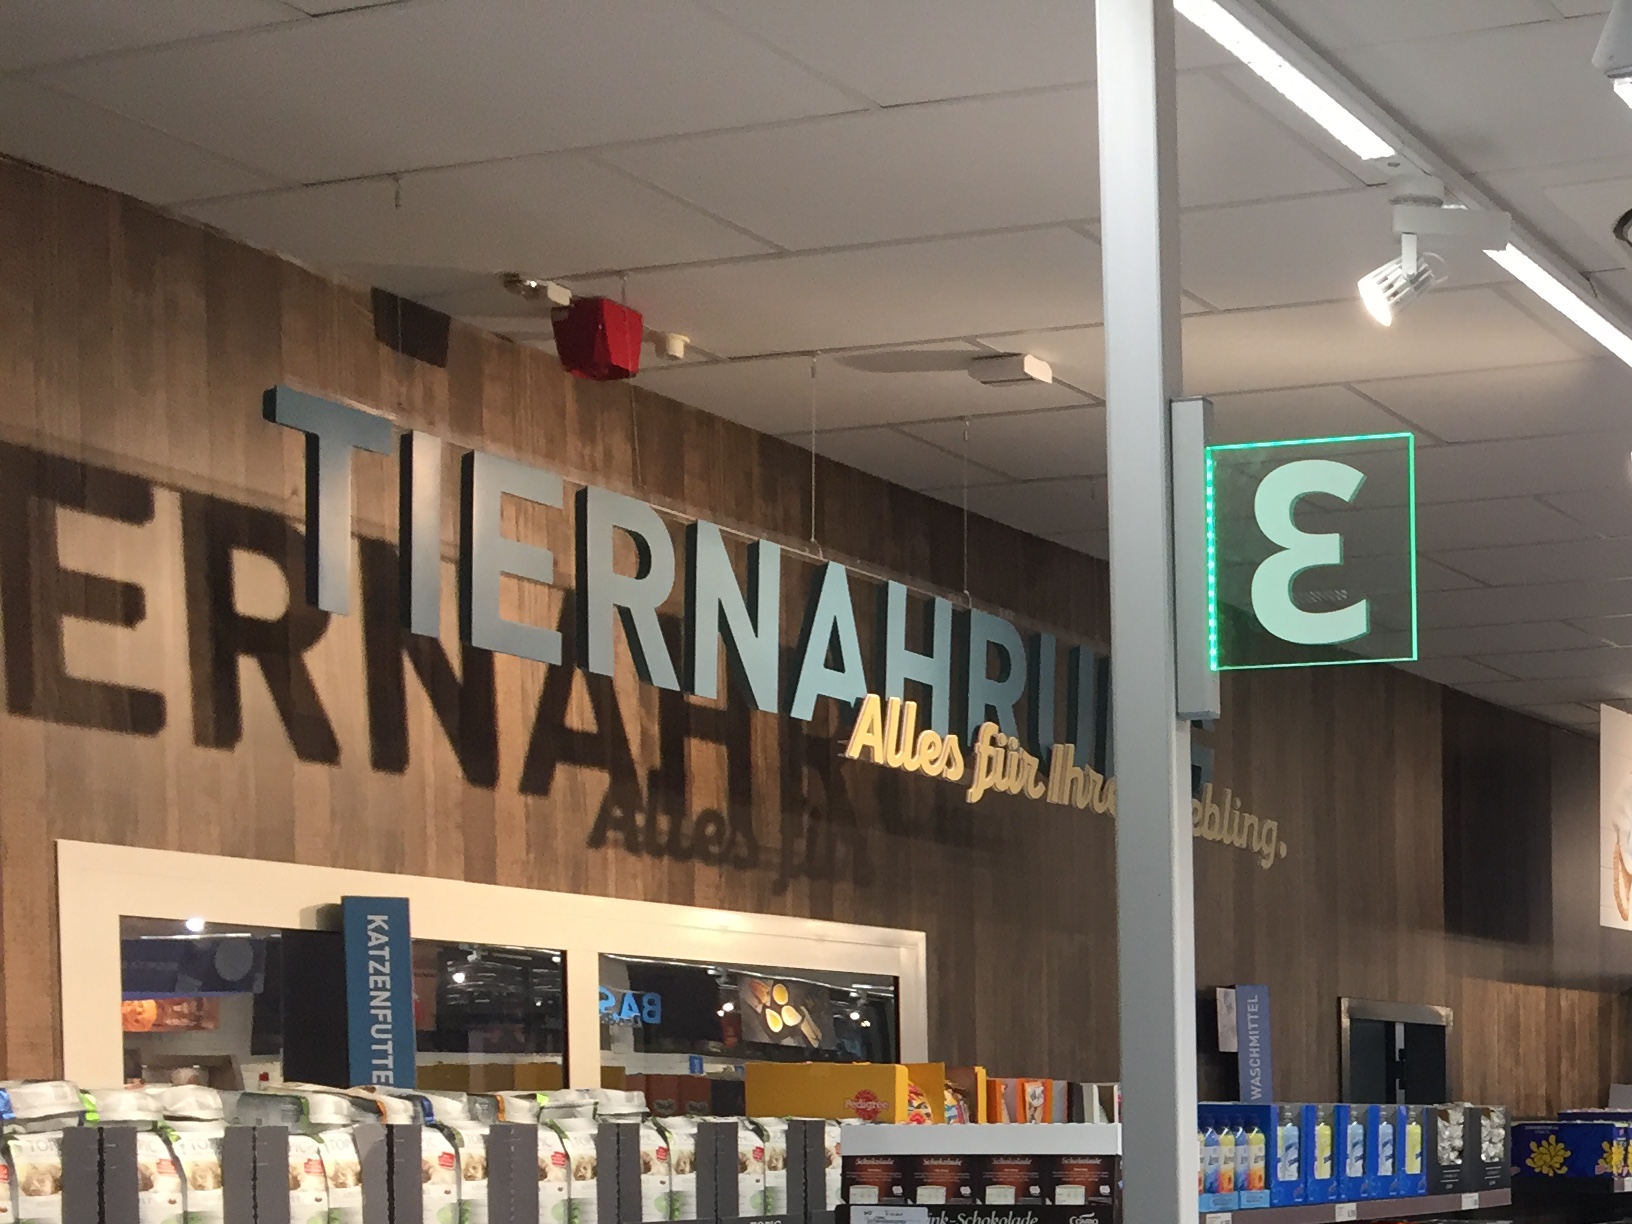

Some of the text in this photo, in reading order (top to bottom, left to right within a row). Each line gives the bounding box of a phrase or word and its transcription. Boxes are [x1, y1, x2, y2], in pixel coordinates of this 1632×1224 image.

[263, 384, 1213, 783] TIERNAHRU
[847, 694, 963, 782] Alles
[967, 722, 1046, 803] für
[1191, 783, 1287, 869] ebling.
[366, 914, 394, 1085] KATZENFUTTE
[1247, 994, 1262, 1100] WASCHMITTEL
[843, 1098, 889, 1113] Pedigree
